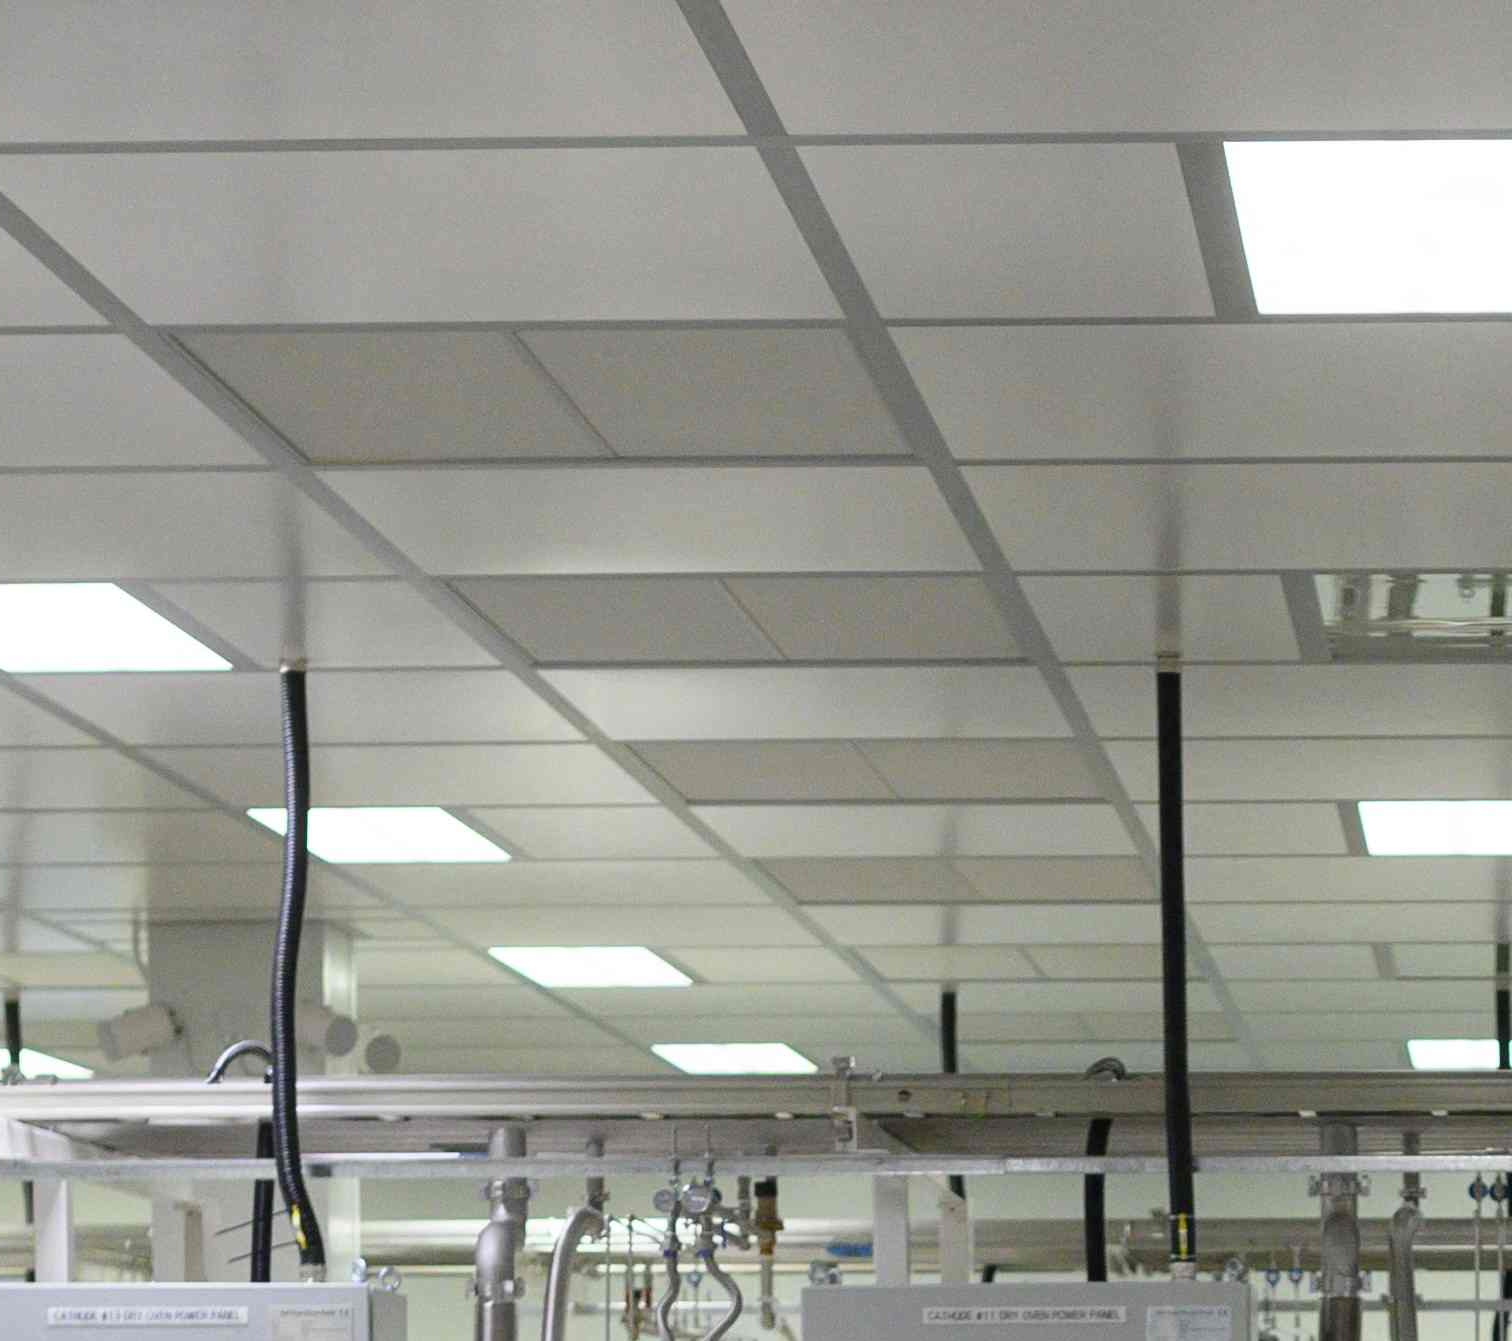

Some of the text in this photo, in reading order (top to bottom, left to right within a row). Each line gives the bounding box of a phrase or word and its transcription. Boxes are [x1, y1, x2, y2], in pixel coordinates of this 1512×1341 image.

[927, 1310, 971, 1320] CATHODE
[999, 1310, 1018, 1320] DRY
[1022, 1310, 1050, 1320] OVEN
[1051, 1310, 1086, 1320] POWER
[1089, 1310, 1120, 1320] PANEL
